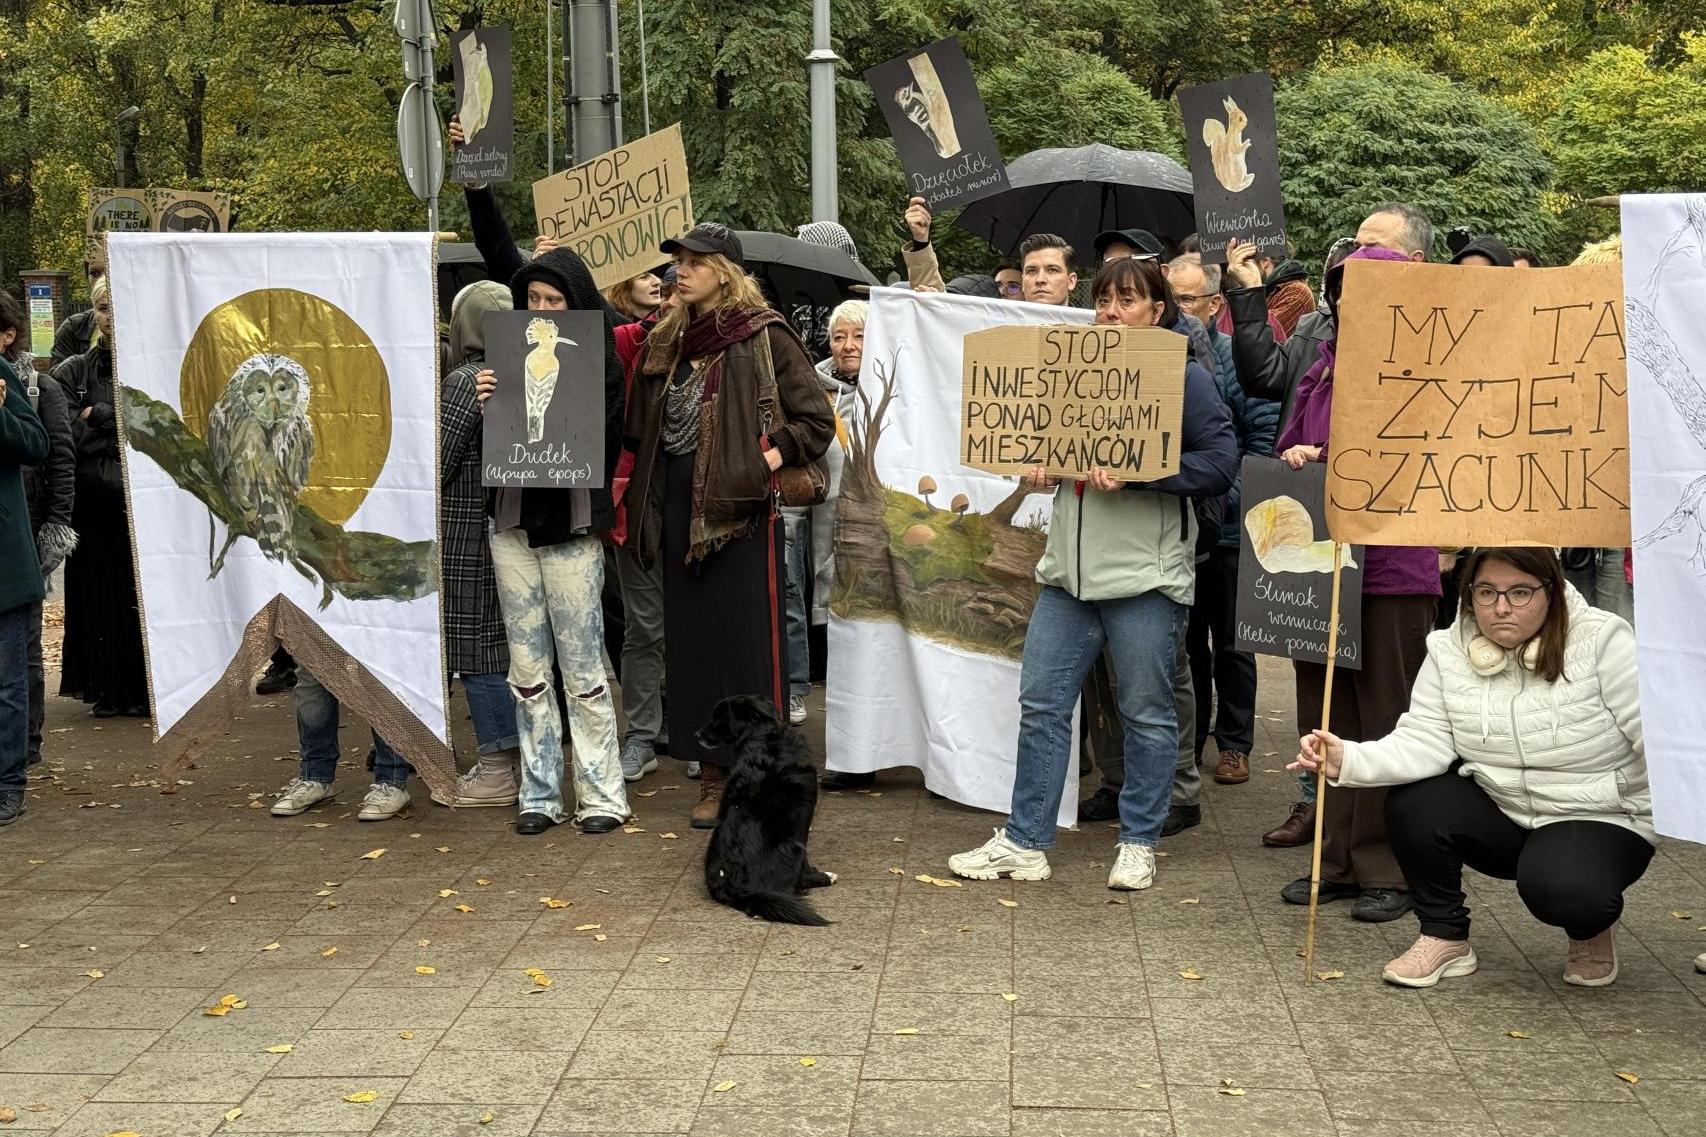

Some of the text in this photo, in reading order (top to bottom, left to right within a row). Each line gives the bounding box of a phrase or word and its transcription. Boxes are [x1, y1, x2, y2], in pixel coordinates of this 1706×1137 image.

[564, 150, 630, 202] STOP
[107, 210, 140, 220] THERE
[541, 158, 670, 240] DEWASTACJI
[110, 220, 139, 229] IS NO
[575, 196, 690, 269] RONOWIC!
[1044, 329, 1121, 366] STOP
[1383, 301, 1627, 366] MY TA
[967, 399, 1161, 431] PONAD GŁOWAMI
[1376, 369, 1627, 440] ŻYJEM
[508, 442, 573, 464] Dudek
[485, 463, 592, 485] (Upupa epops)
[1330, 447, 1631, 516] SZACUNK
[1254, 573, 1320, 609] Ślimak
[1237, 621, 1357, 662] (Helix pomaia)
